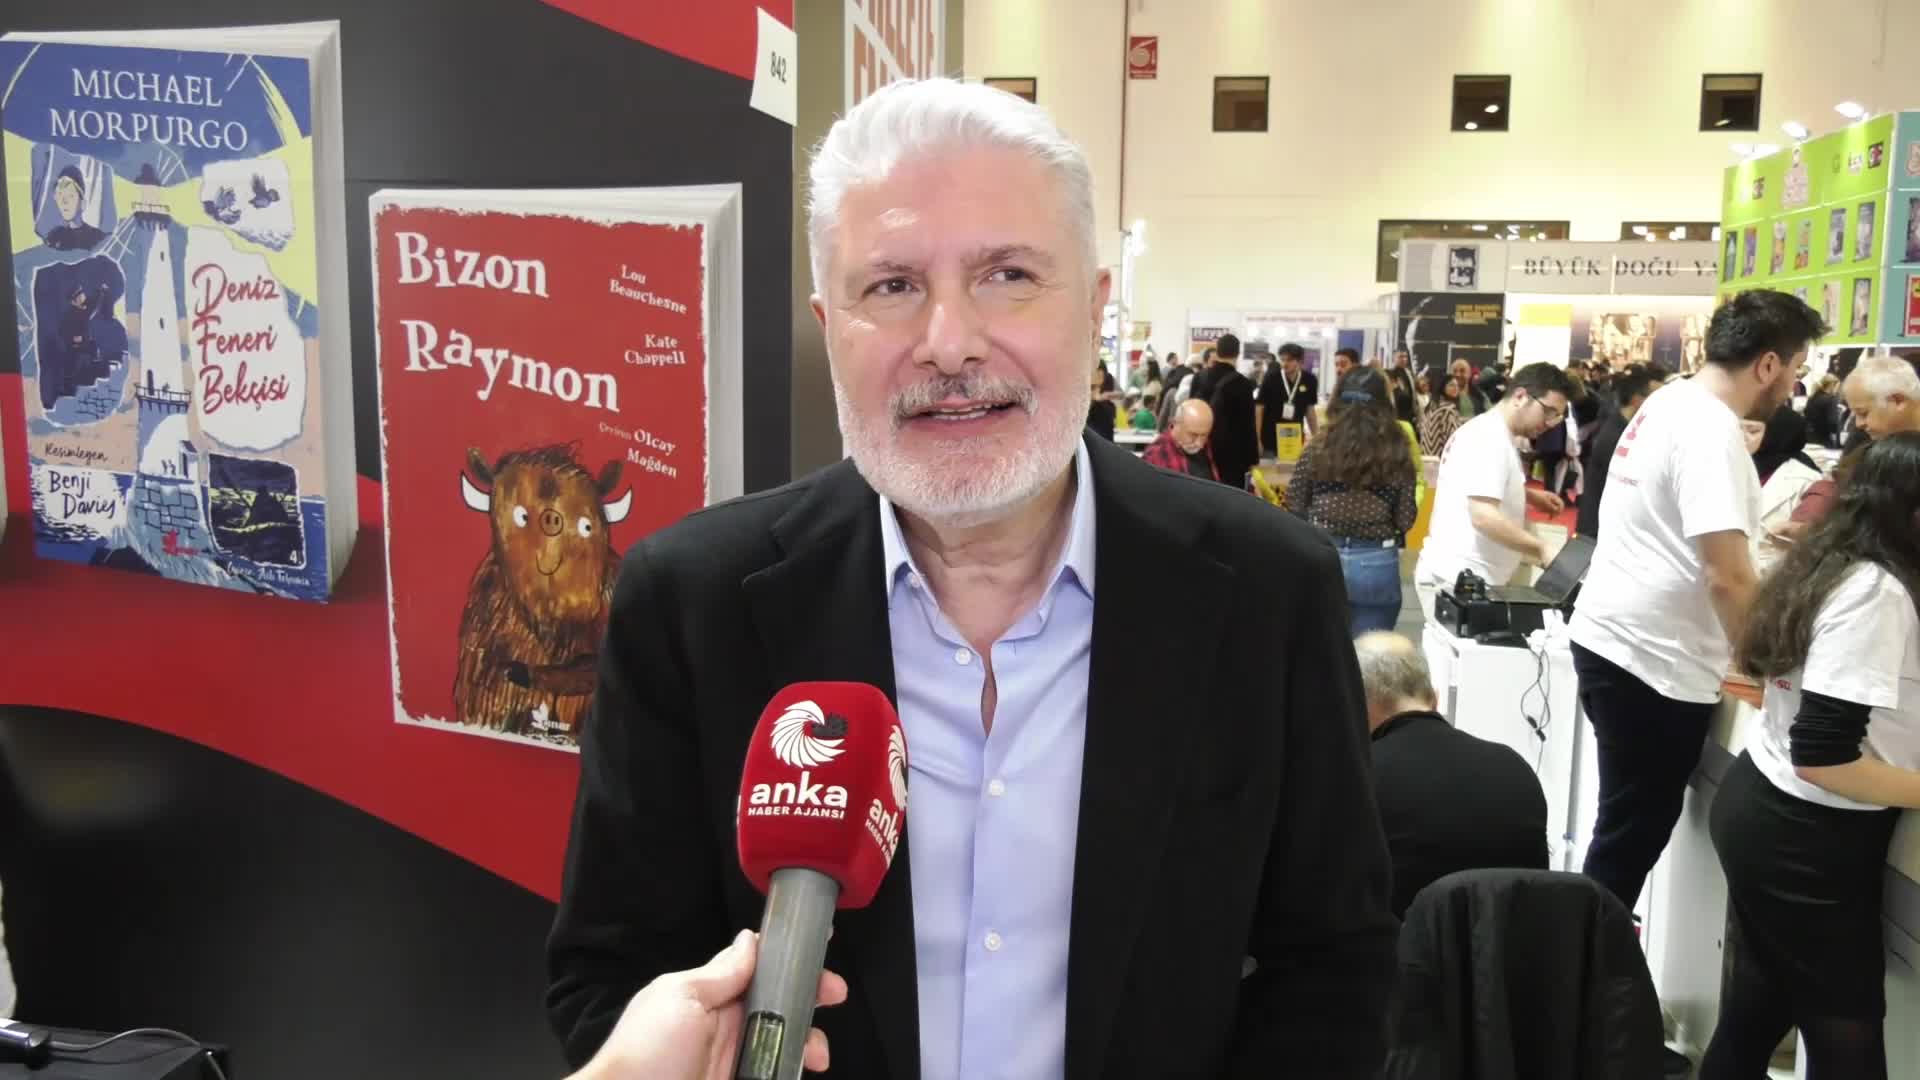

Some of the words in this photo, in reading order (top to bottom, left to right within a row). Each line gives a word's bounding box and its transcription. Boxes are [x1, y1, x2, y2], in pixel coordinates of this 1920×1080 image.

[771, 51, 786, 84] 842
[71, 68, 223, 107] MICHAEL
[49, 108, 248, 151] MORPURGO
[395, 231, 549, 298] Bizon
[621, 264, 647, 284] Lou
[1524, 256, 1601, 276] BÜYÜK
[1614, 256, 1680, 277] DOĞU
[192, 263, 281, 317] Deniz
[192, 315, 278, 366] Feneri
[644, 333, 678, 349] Kate
[400, 319, 620, 413] Raymon
[624, 350, 686, 366] Chappell
[199, 360, 291, 415] Bekçisi
[634, 428, 676, 456] Olcay
[48, 470, 91, 498] Benji
[62, 493, 116, 519] Davies
[750, 771, 848, 809] anka
[748, 806, 791, 816] HABER
[794, 806, 845, 819] AJANSI
